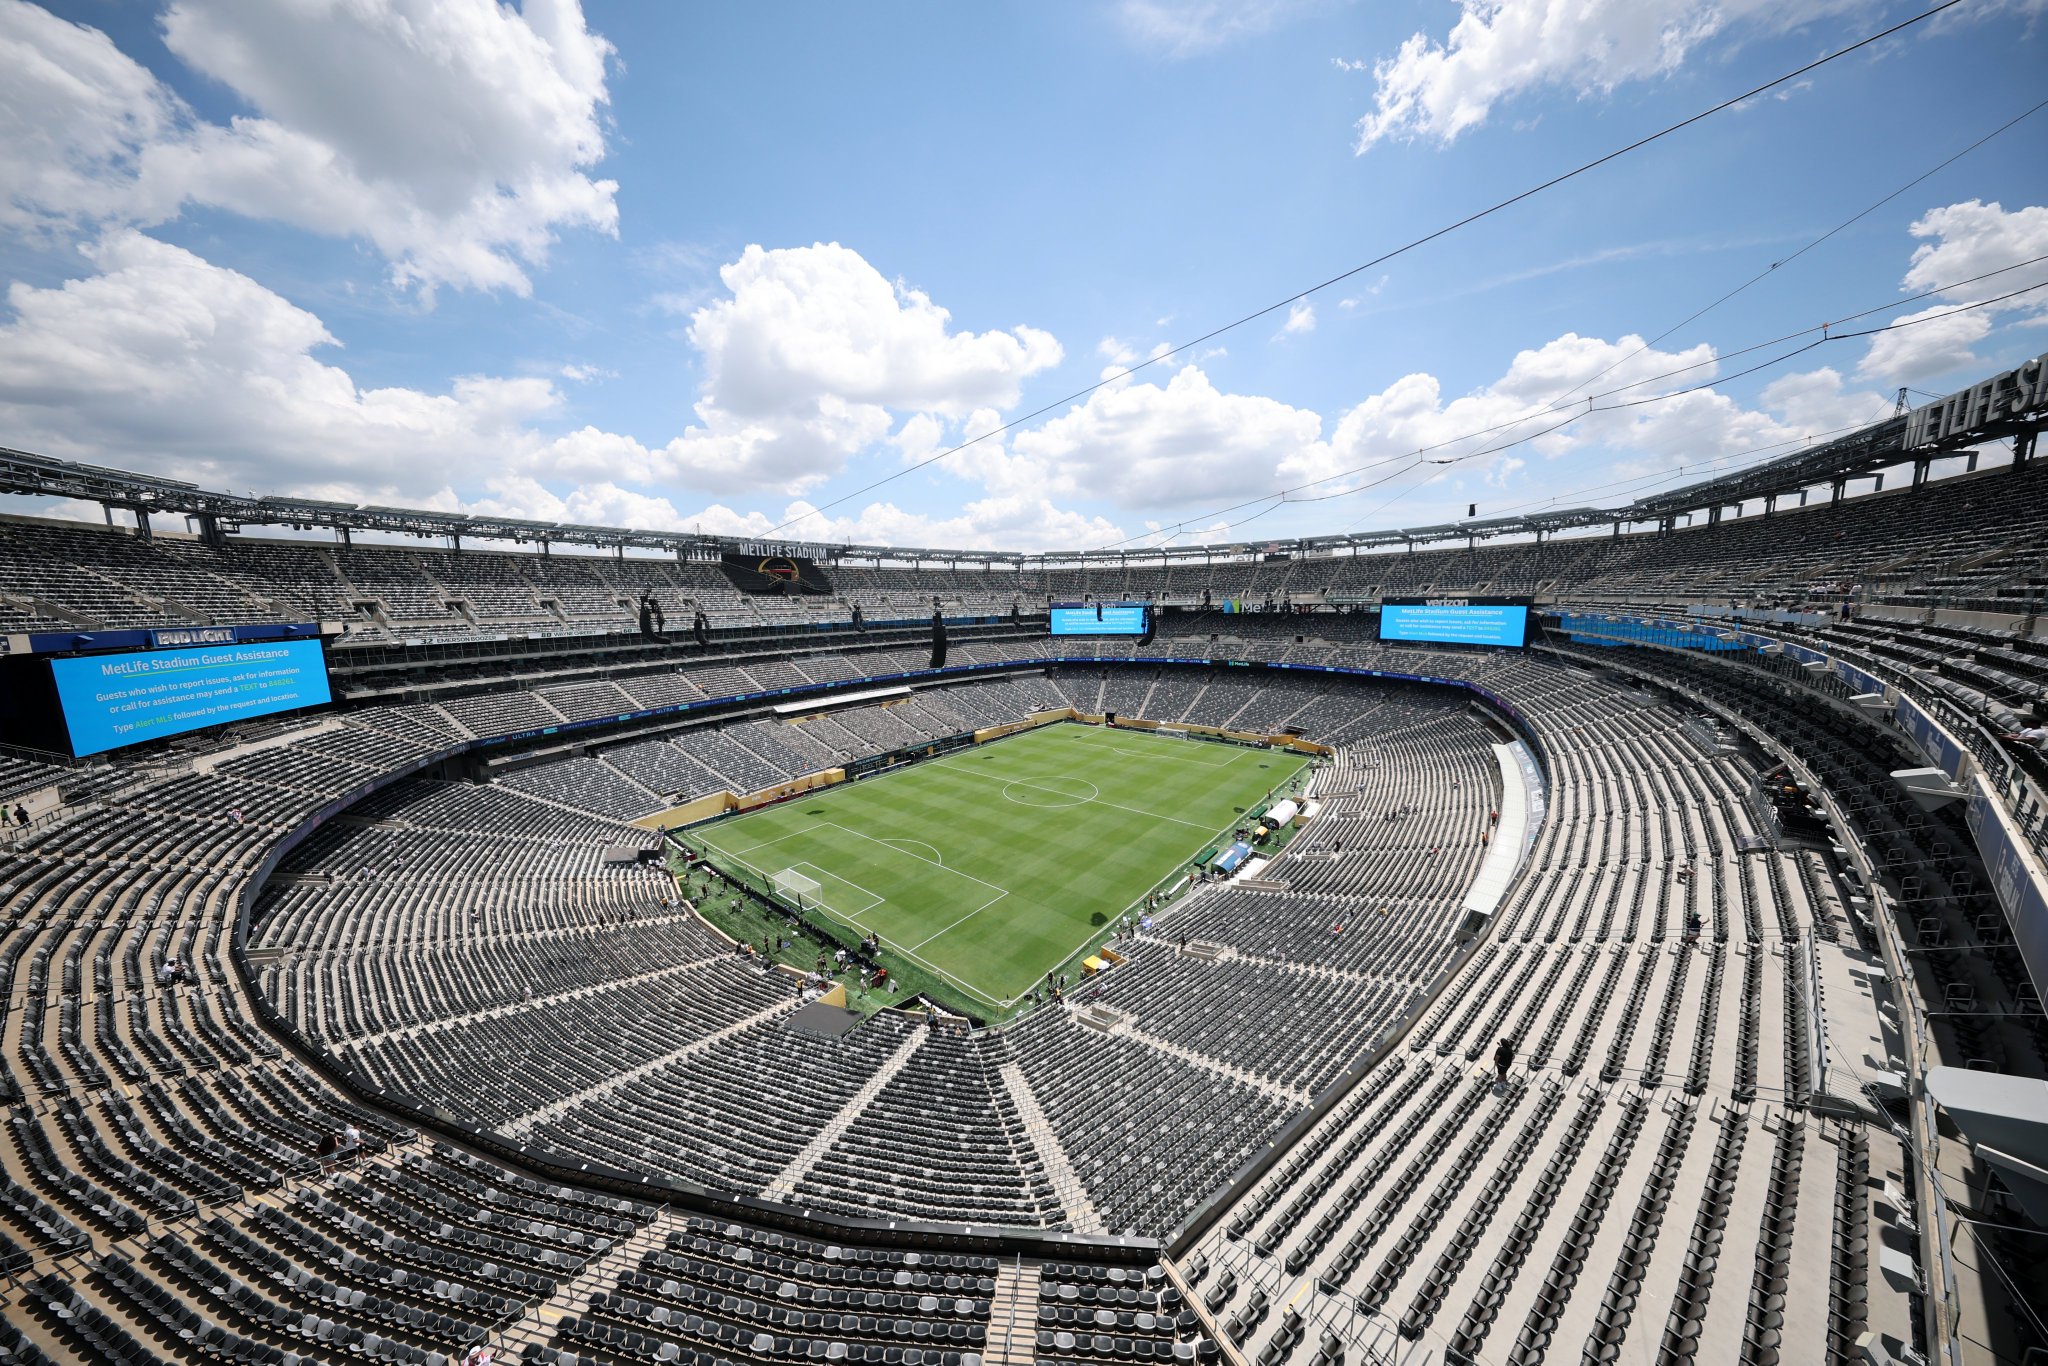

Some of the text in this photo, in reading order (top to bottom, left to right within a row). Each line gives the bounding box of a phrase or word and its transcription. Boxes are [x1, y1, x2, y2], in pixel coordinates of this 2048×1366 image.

[1902, 352, 2048, 450] METLIFE ST
[740, 543, 827, 560] METLIFE STADIUM
[1426, 596, 1468, 606] verizon
[156, 629, 234, 645] BUD LIGHT
[102, 650, 289, 676] MetLife Stadium Guest Assistance
[96, 690, 127, 702] Guests
[128, 688, 146, 696] who
[148, 684, 167, 694] wish
[180, 680, 206, 690] report
[206, 677, 232, 685] issues,
[259, 668, 300, 678] information
[121, 702, 137, 712] call
[138, 700, 150, 708] for
[153, 693, 195, 706] assistance
[196, 690, 212, 698] may
[214, 686, 232, 695] send
[240, 683, 257, 691] TEXT
[113, 724, 134, 734] Type
[135, 718, 154, 728] Alert
[174, 708, 205, 720] followed
[230, 700, 256, 709] request
[271, 693, 299, 702] location.
[512, 731, 536, 740] ULTRA
